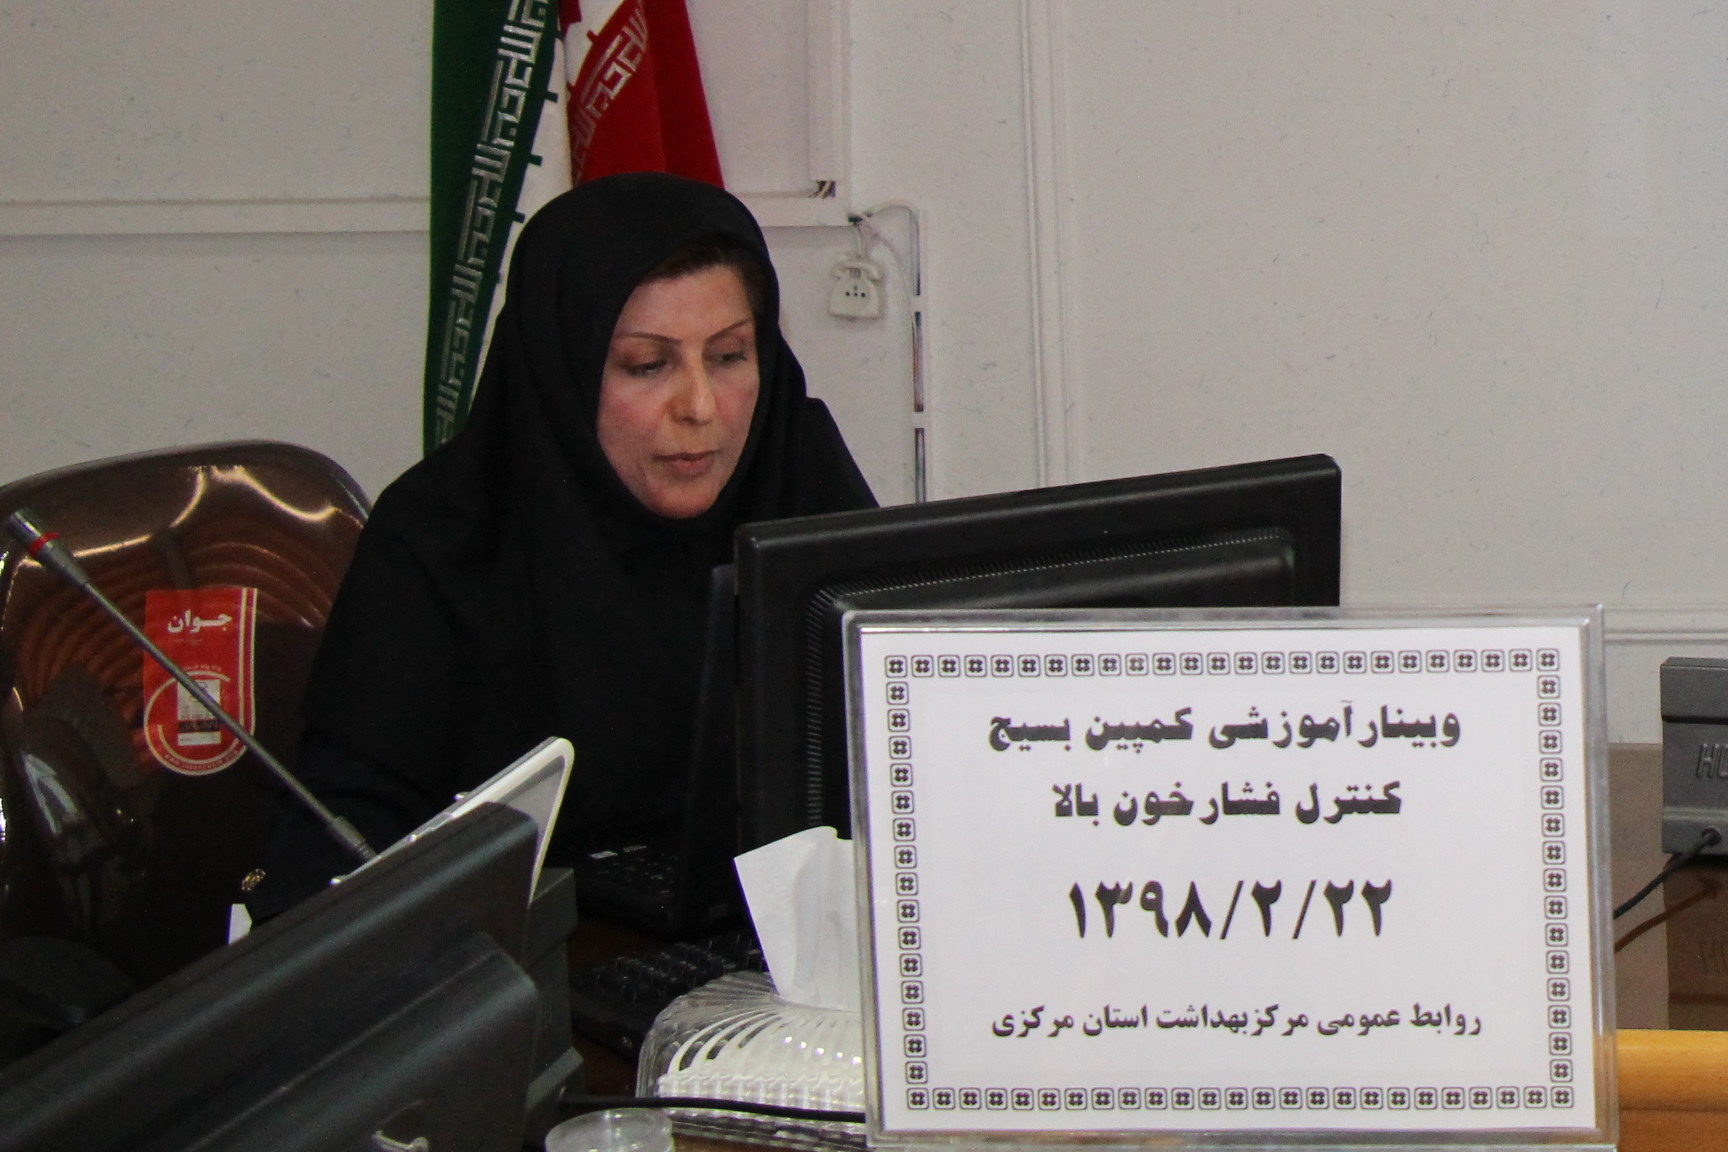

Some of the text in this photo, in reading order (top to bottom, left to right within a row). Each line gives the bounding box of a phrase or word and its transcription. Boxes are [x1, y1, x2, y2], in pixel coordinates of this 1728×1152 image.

[167, 608, 233, 633] جوان
[988, 700, 1461, 753] وبینار آموزشی کمپین بسیج
[1052, 780, 1402, 827] کنترل فشار خون بالا
[992, 1003, 1481, 1038] روابط عمومی مرکز بهداشت استان مرکزی
